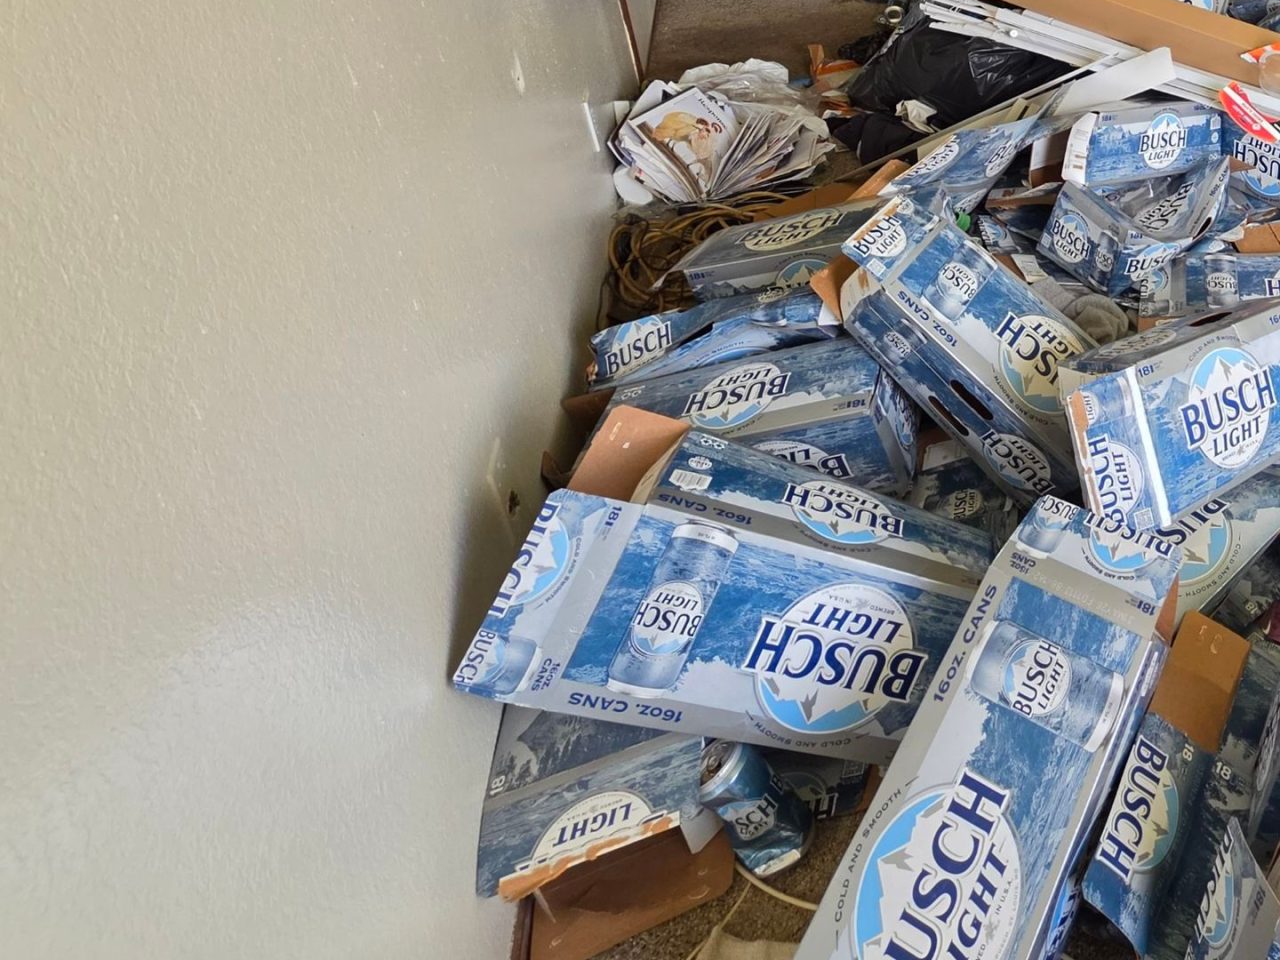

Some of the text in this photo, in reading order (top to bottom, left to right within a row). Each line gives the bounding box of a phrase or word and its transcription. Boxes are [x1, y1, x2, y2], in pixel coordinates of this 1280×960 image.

[1140, 128, 1187, 153] BUSCH
[1148, 149, 1177, 161] LIGHT
[739, 212, 843, 243] BUSCH
[754, 230, 812, 246] LIGHT
[853, 215, 901, 257] BUSCH
[876, 226, 902, 255] LIGHT
[1052, 219, 1090, 258] BUSCH
[1055, 238, 1080, 259] LIGHT
[1126, 253, 1168, 274] BUSC
[940, 264, 977, 299] BUSCH
[949, 264, 978, 288] LIGHT
[896, 290, 931, 323] CANS
[606, 323, 672, 375] BUSCH
[683, 374, 790, 415] BUSCH
[713, 367, 771, 388] LIGHT
[1182, 369, 1276, 446] BUSCH
[1212, 416, 1262, 457] LIGHT
[982, 429, 1056, 496] BUSCH
[1010, 439, 1047, 477] LIGHT
[1114, 452, 1134, 502] LIGHT
[815, 485, 880, 510] LIGHT
[1088, 437, 1123, 526] BUSCH
[657, 492, 709, 515] CANS
[783, 483, 904, 538] BUSCH
[1039, 495, 1081, 522] BUSCH
[632, 602, 704, 637] BUSCH
[652, 591, 700, 612] LIGHT
[963, 583, 998, 644] CANS
[803, 602, 904, 644] LIGHT
[748, 618, 927, 701] BUSCH
[1012, 641, 1060, 717] BUSCH
[1037, 660, 1066, 711] LIGHT
[567, 692, 629, 714] CANS
[795, 737, 816, 750] AND
[820, 732, 851, 753] COLD
[1215, 761, 1233, 780] 18
[552, 801, 633, 847] LIGHT
[1101, 738, 1168, 879] BUSCH
[834, 788, 902, 923] COLD AND SMOOTH
[885, 772, 1007, 960] USCH
[945, 842, 1008, 960] IGHT
